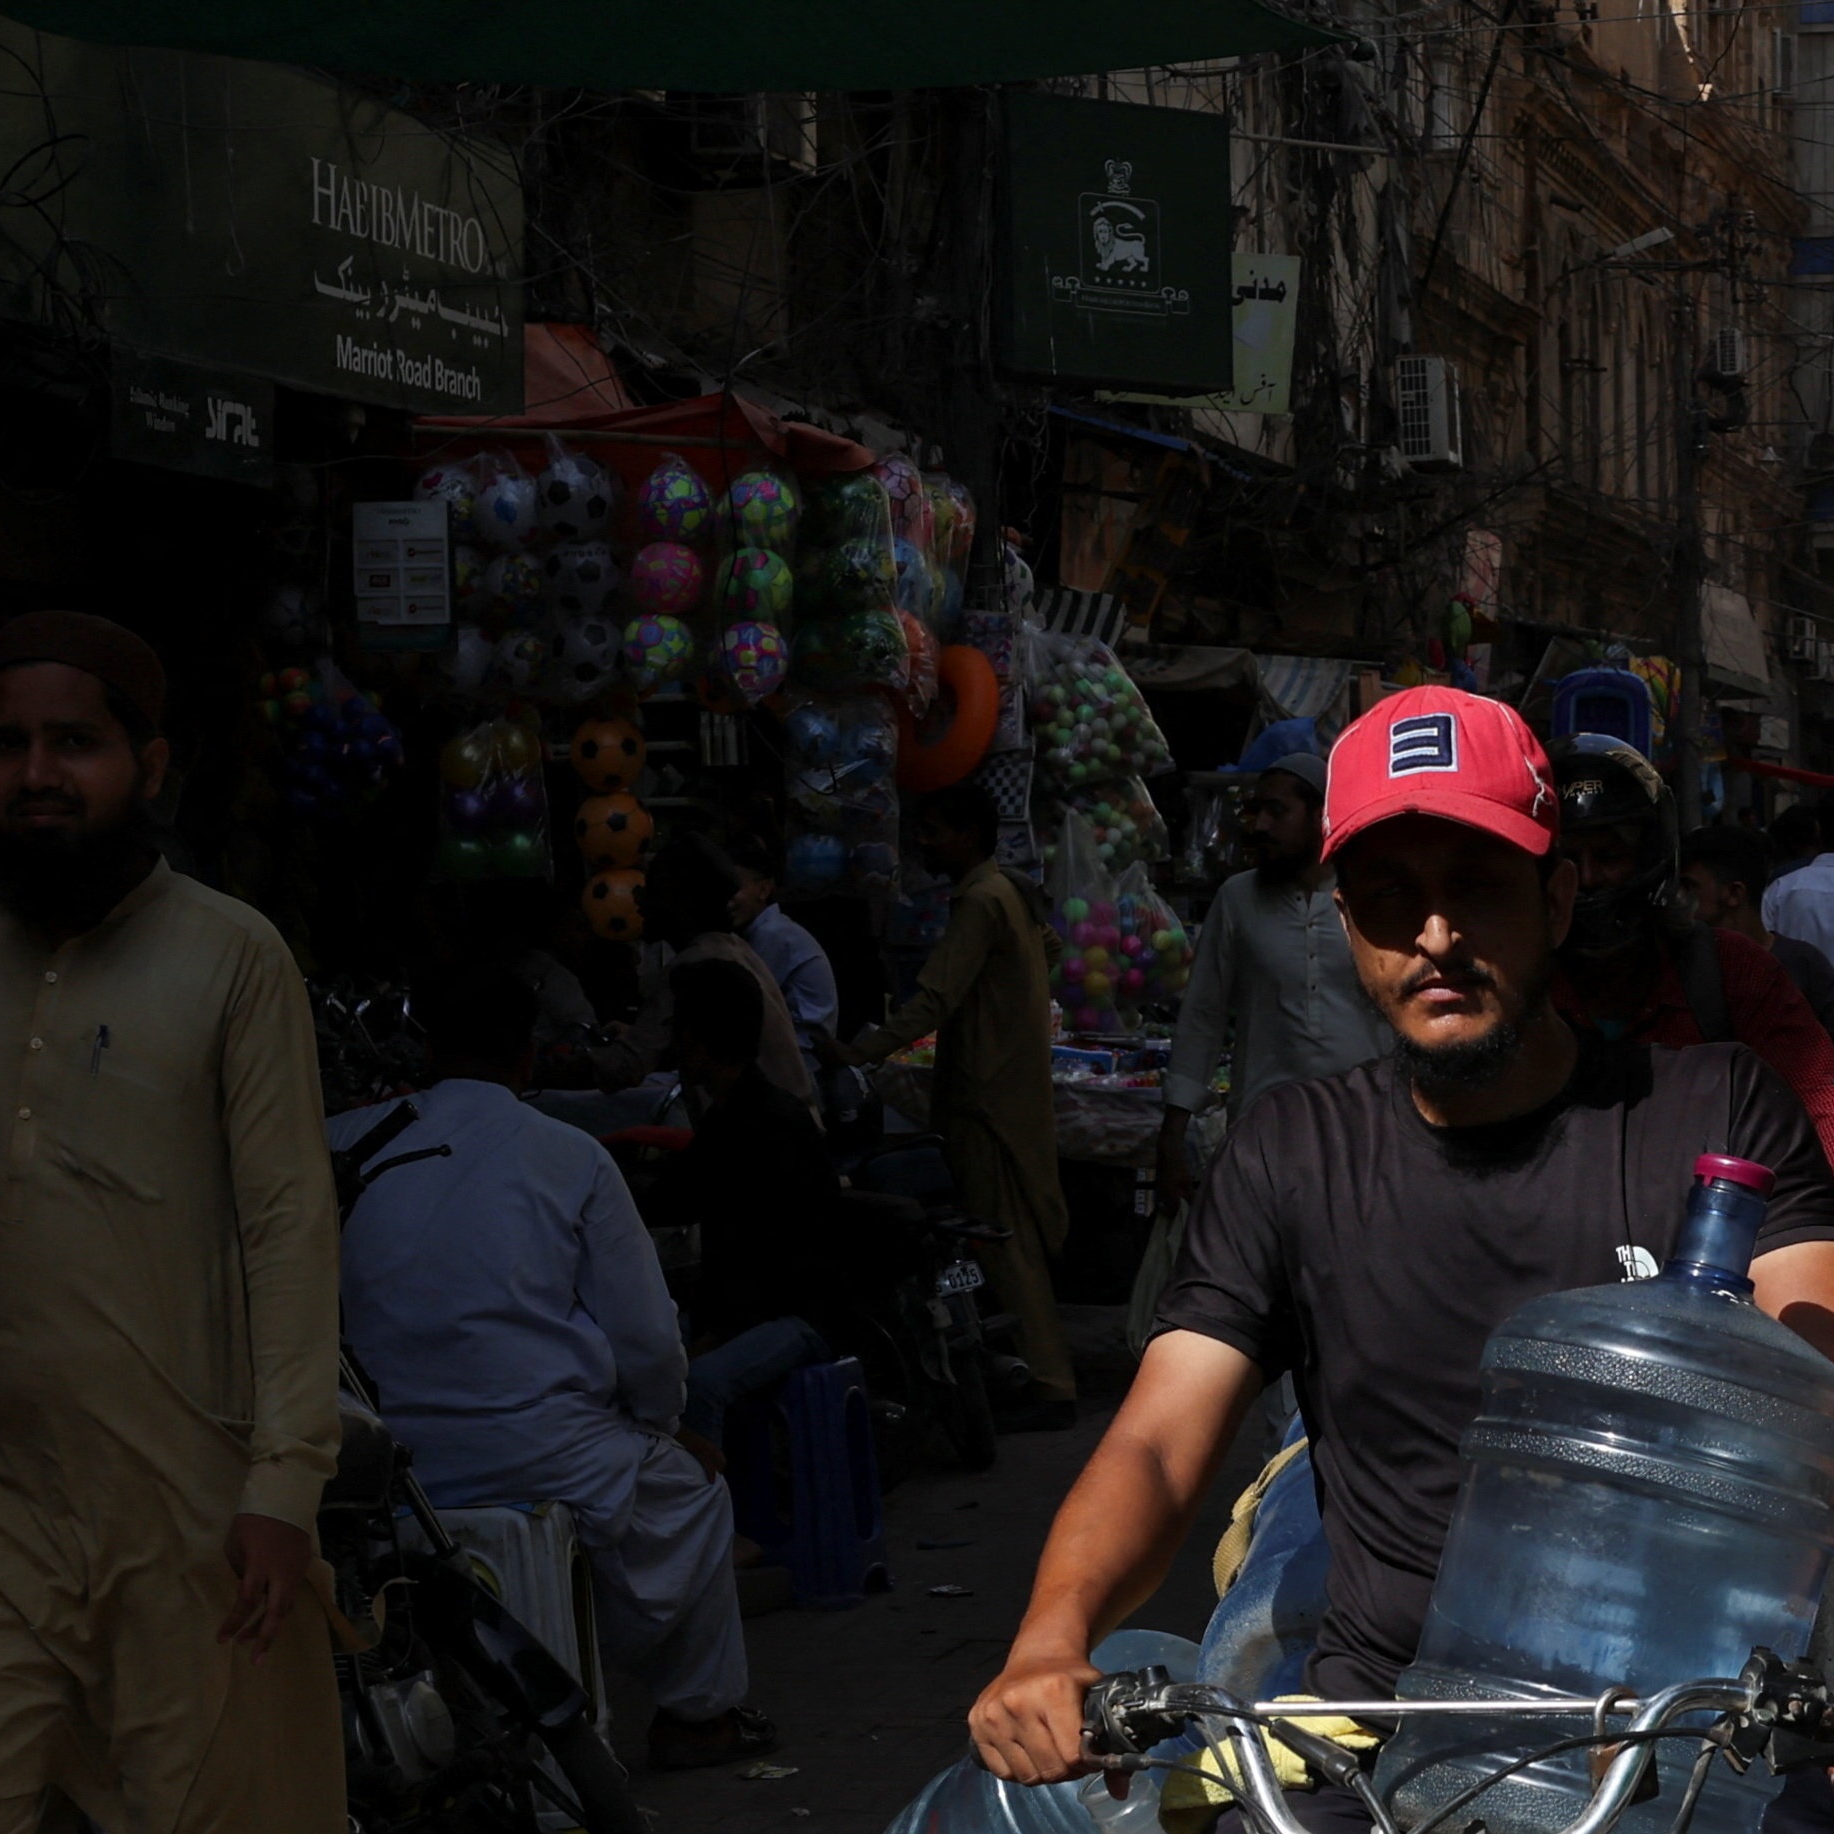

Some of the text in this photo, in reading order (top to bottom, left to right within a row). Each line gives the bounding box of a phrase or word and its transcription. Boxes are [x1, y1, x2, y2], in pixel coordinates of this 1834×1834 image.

[336, 333, 481, 402] Marriot Road Branch
